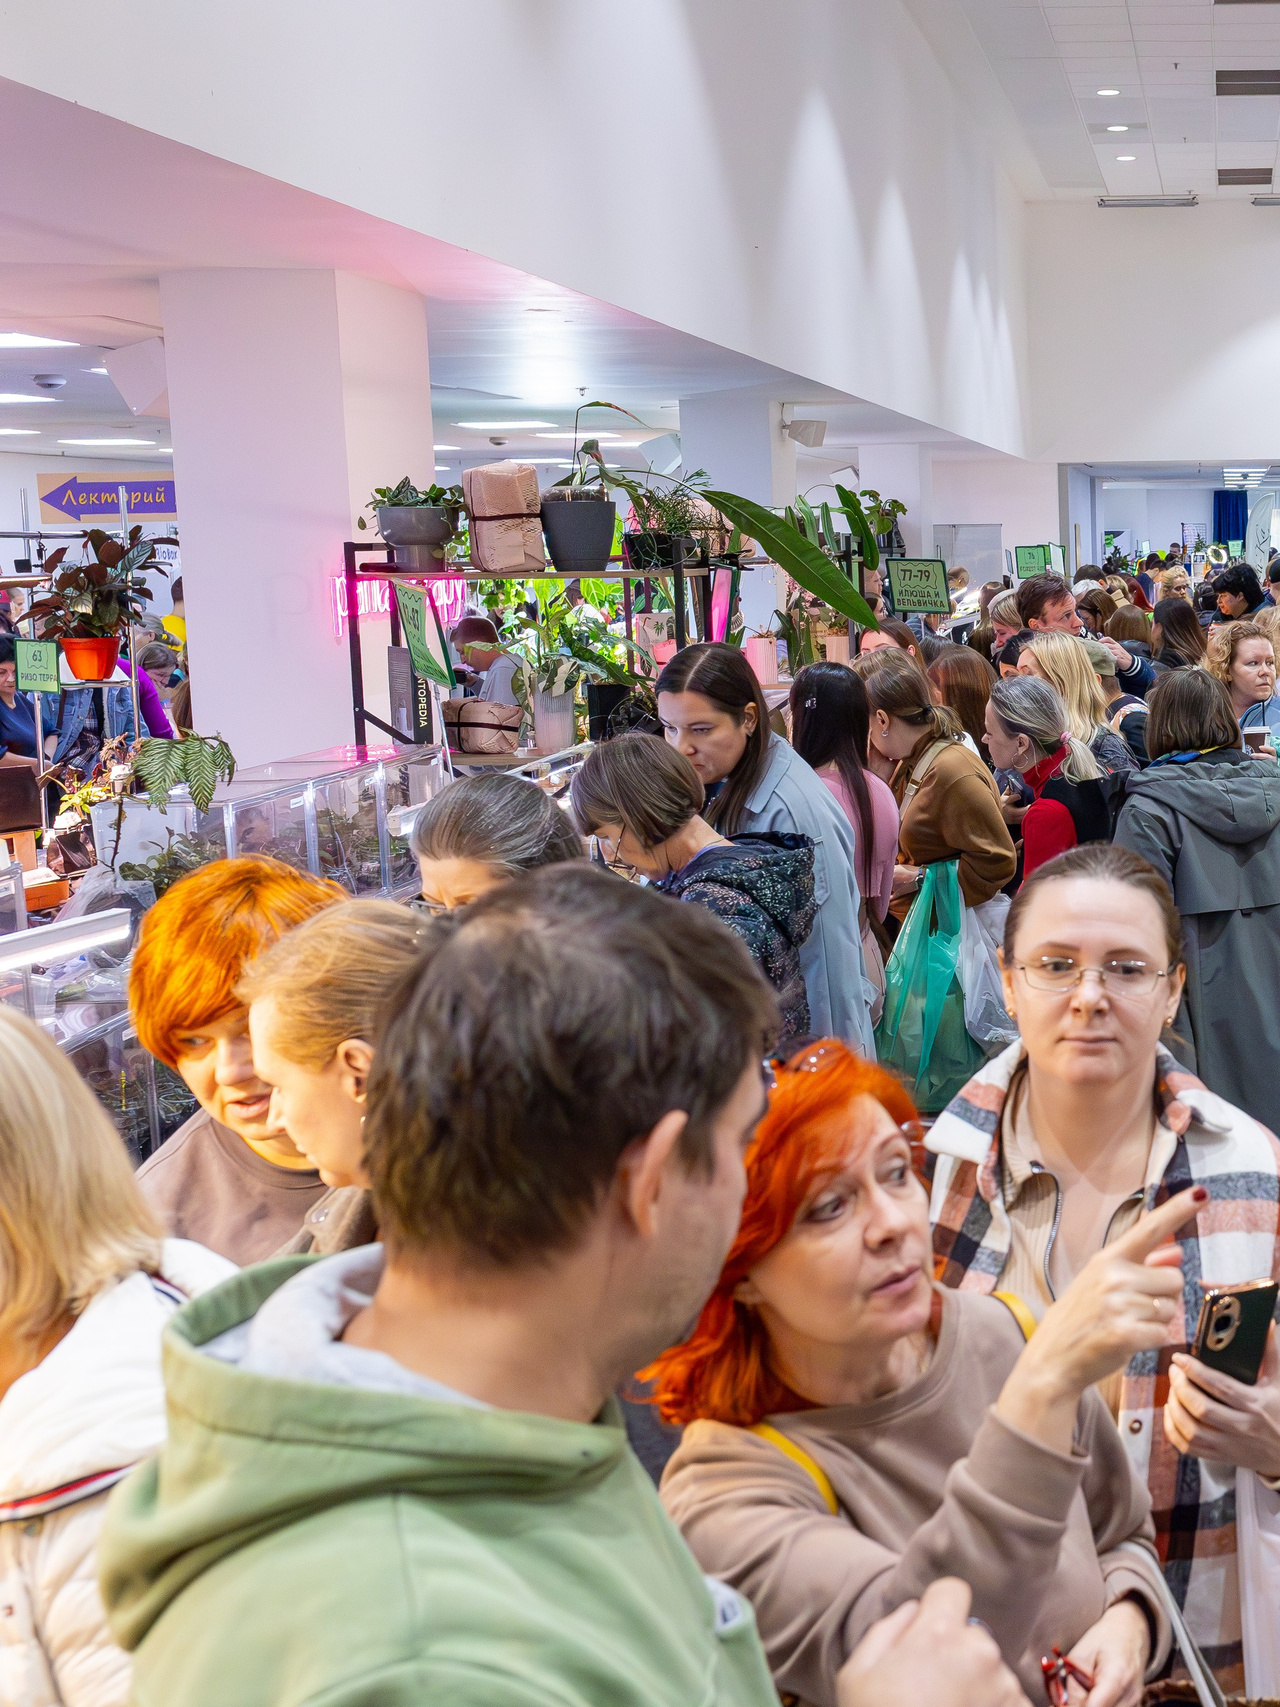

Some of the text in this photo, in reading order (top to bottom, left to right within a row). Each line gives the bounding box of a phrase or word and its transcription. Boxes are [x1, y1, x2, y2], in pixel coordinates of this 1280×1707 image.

[61, 486, 166, 510] Лектрий
[900, 568, 931, 581] 77-79
[898, 589, 941, 599] ИЛЮША И
[896, 598, 946, 608] ВЕЛЬВИЧКА
[32, 650, 43, 662] 63
